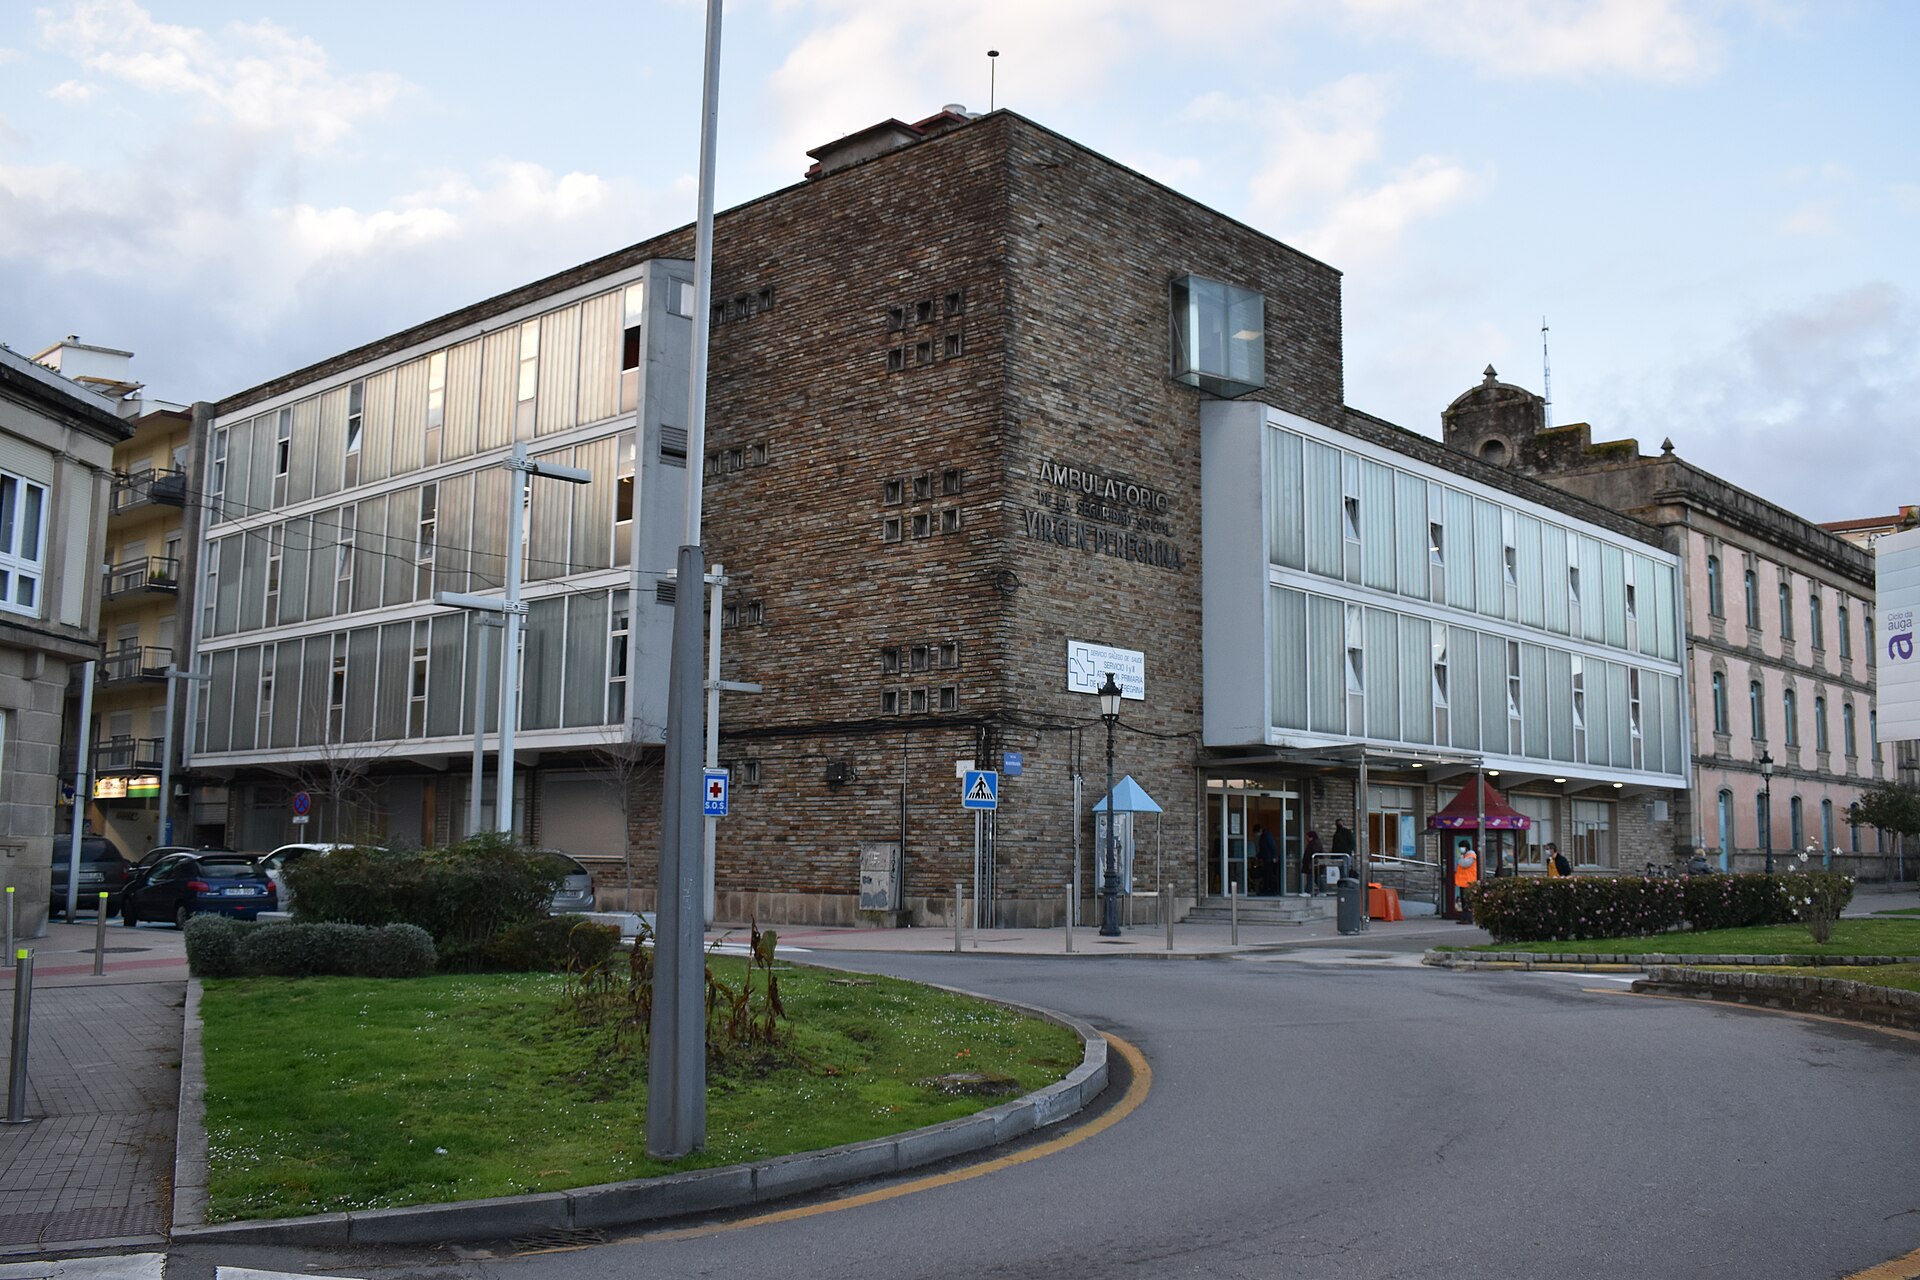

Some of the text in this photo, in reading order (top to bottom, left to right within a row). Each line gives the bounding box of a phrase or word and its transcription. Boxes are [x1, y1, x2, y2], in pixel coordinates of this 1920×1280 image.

[1040, 461, 1169, 513] AMBULATORIO
[1038, 490, 1052, 506] DE
[1057, 495, 1071, 512] LA
[1076, 500, 1132, 527] SEGURIDAD
[1025, 510, 1182, 570] VIRGEN PEREGRINA
[1888, 613, 1903, 621] Ciclo
[1888, 618, 1912, 631] auga
